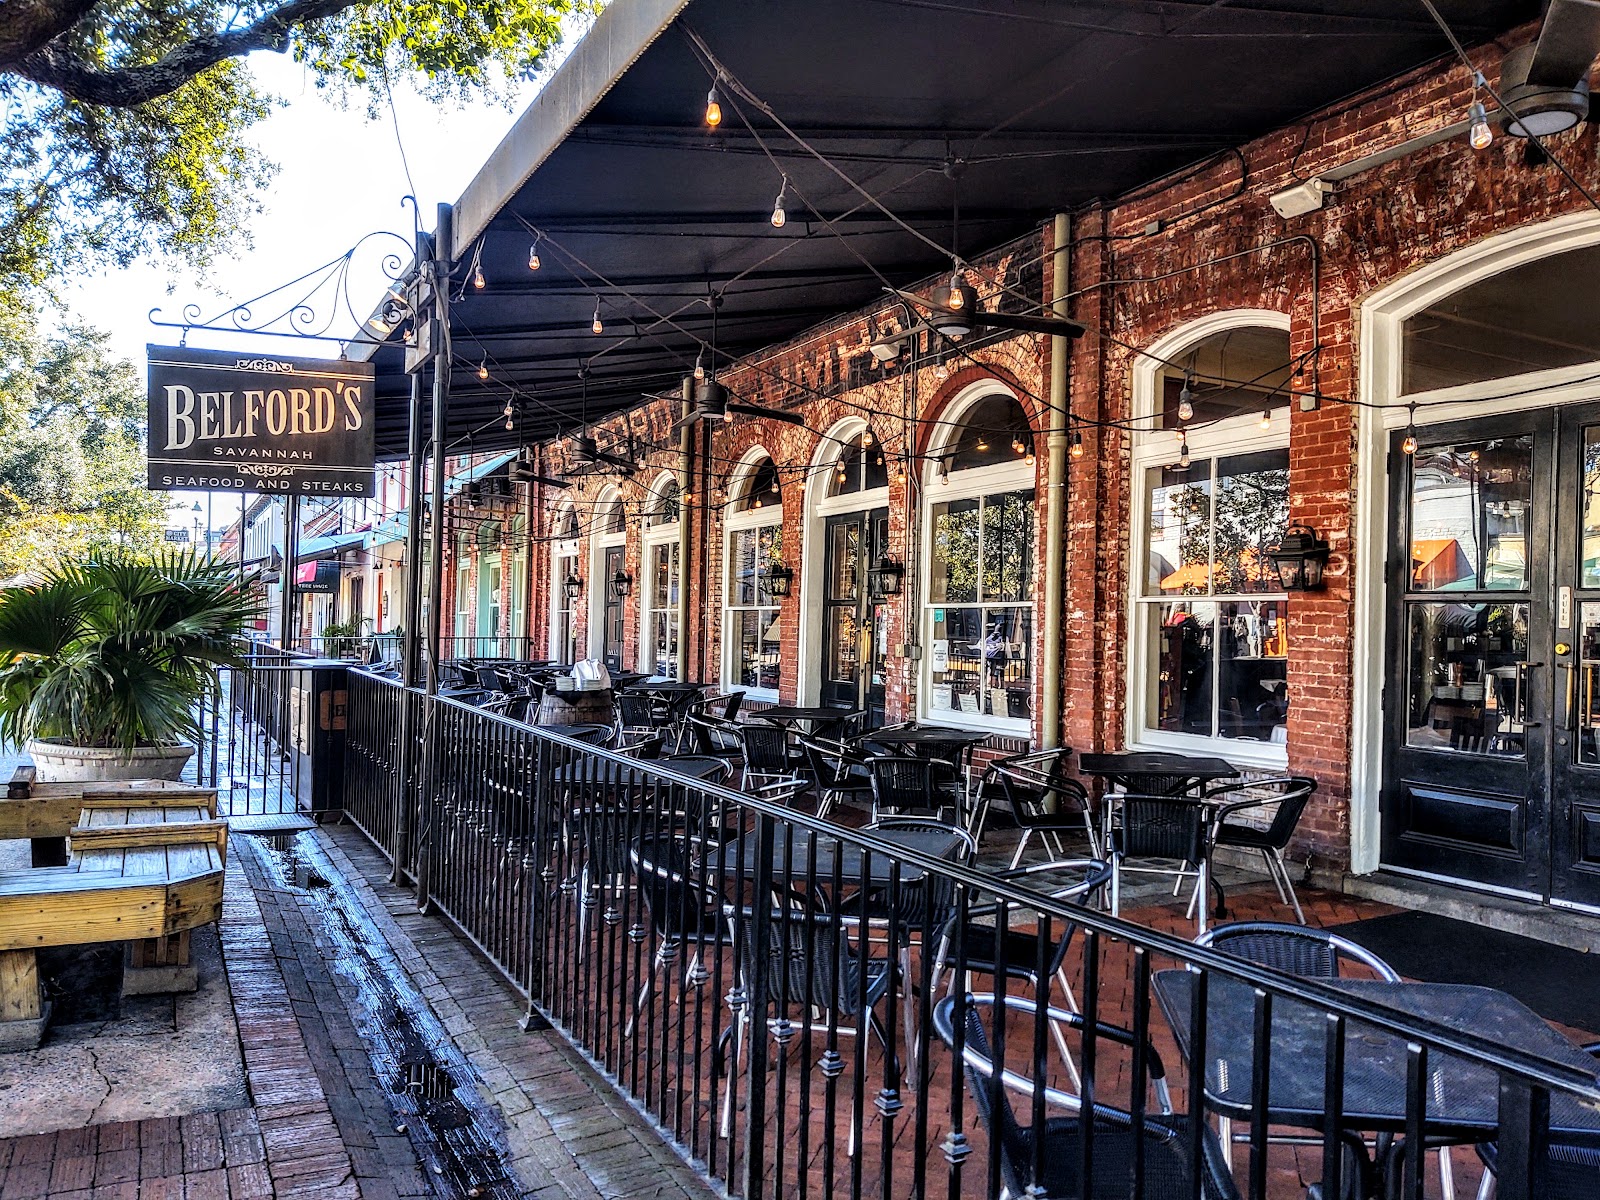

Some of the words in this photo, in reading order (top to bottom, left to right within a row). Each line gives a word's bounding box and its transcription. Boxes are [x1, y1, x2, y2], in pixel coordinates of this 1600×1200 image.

[163, 382, 362, 450] BELFORD'S
[213, 447, 313, 460] SAVANNAH
[162, 476, 245, 487] SEAFOOD
[255, 479, 290, 489] AND
[301, 481, 364, 492] STEAKS
